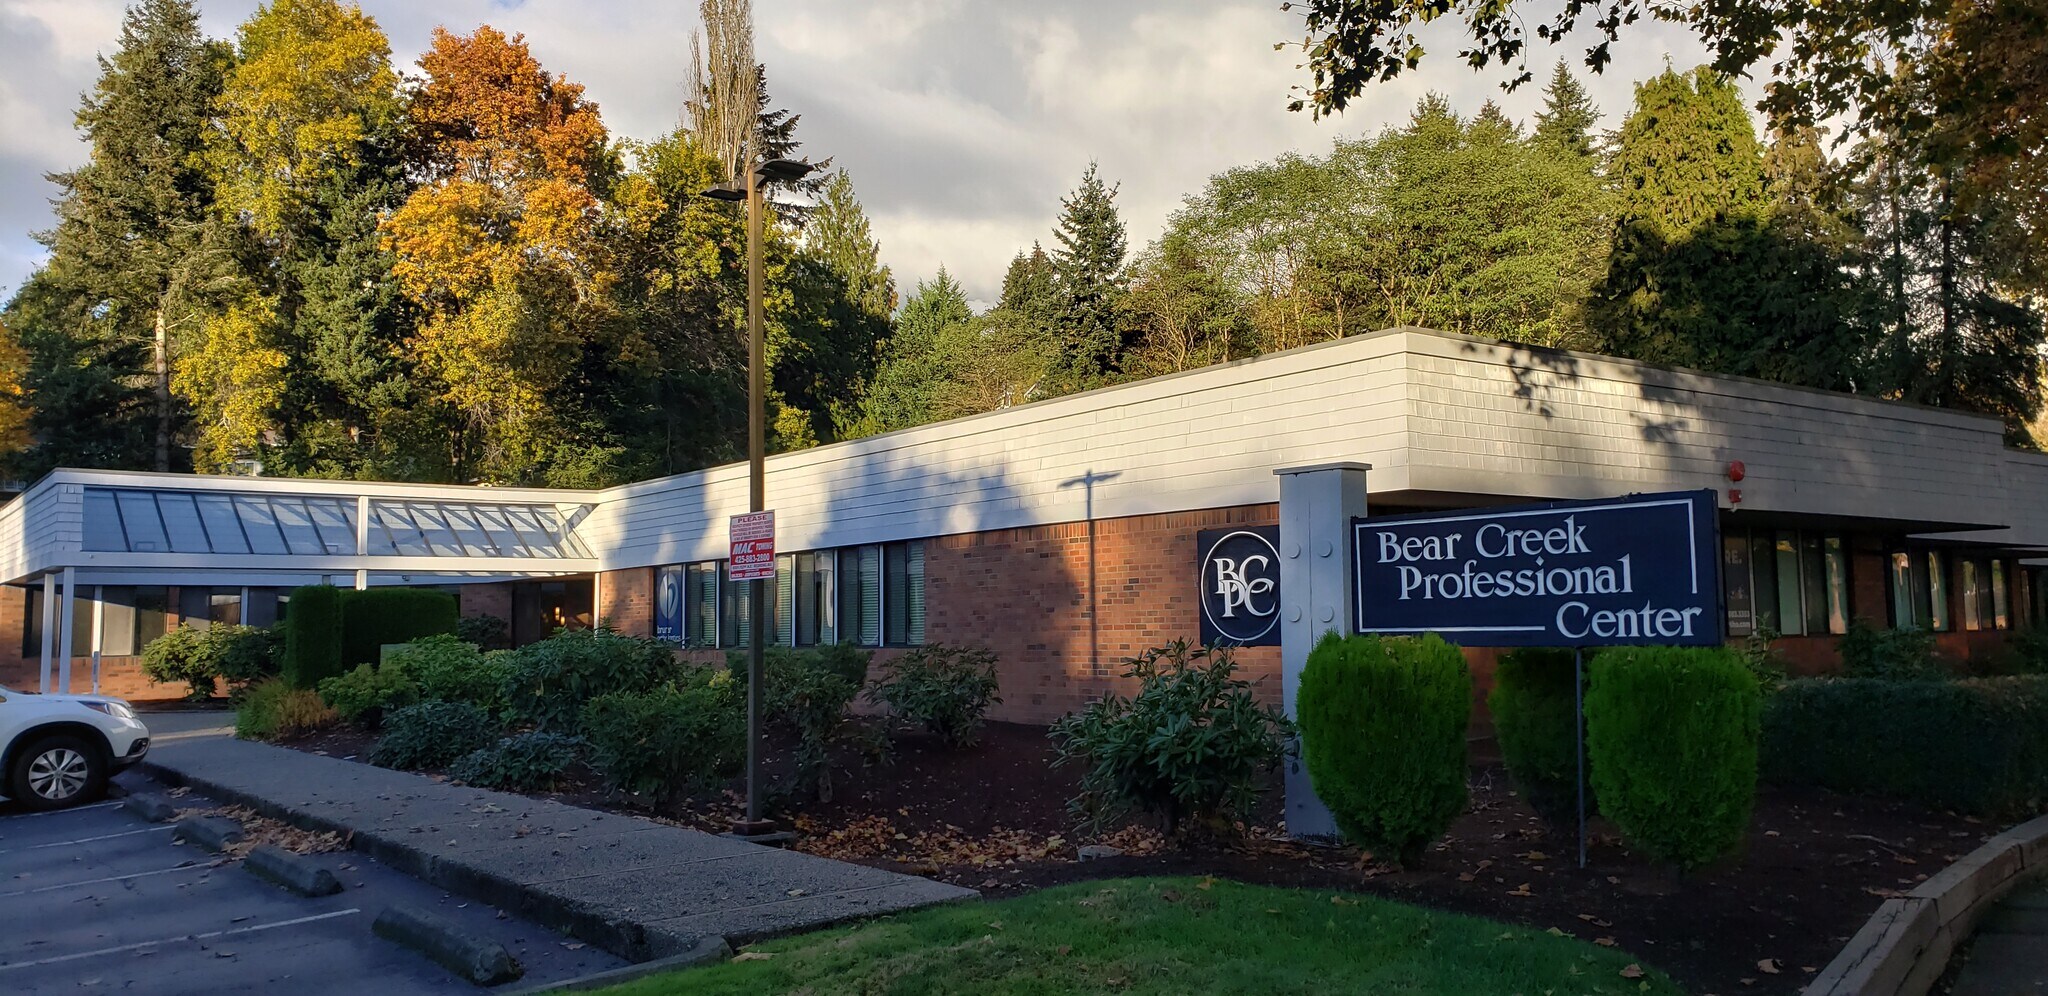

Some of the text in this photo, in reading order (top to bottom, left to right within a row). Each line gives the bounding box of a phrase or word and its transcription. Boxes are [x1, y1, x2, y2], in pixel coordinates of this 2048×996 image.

[737, 515, 767, 523] PLEASE
[1376, 514, 1592, 563] Bear Creek
[732, 542, 755, 554] MAC
[1395, 552, 1634, 600] Professional
[1555, 600, 1703, 639] Center
